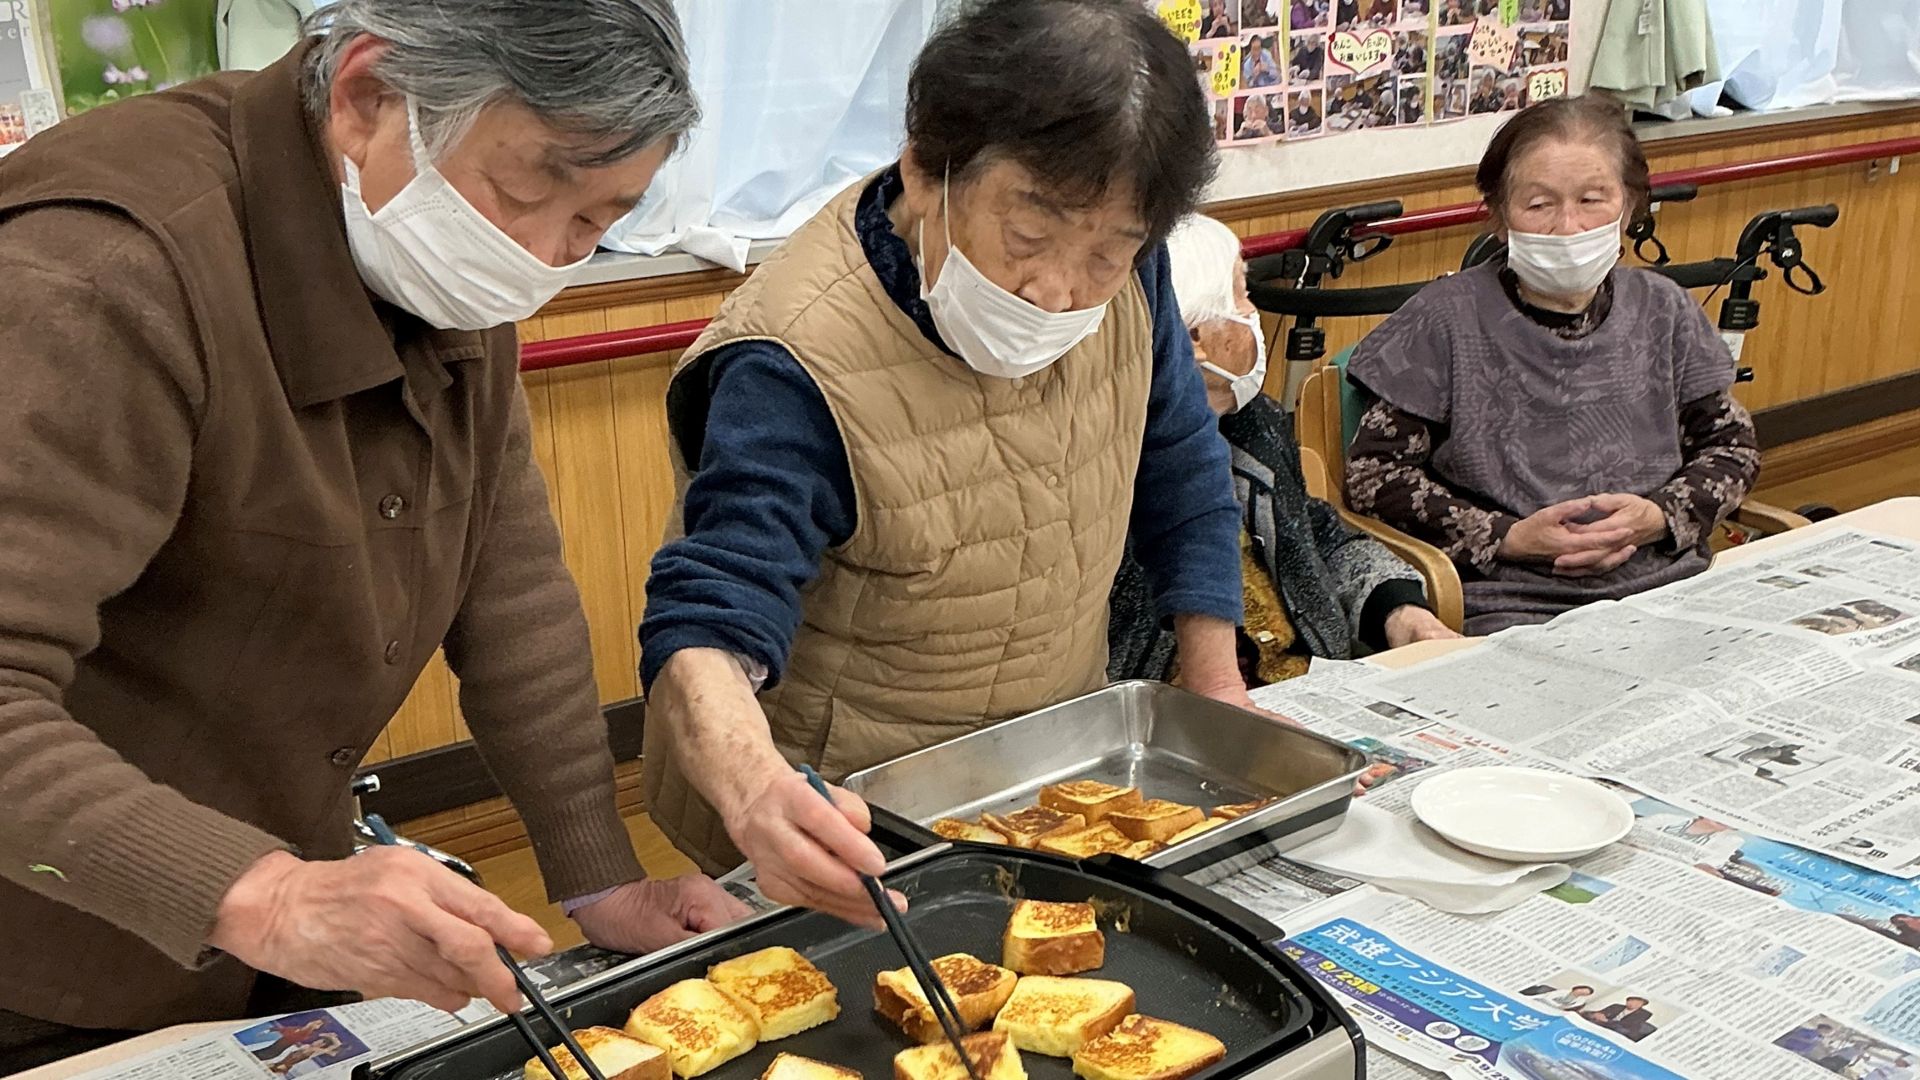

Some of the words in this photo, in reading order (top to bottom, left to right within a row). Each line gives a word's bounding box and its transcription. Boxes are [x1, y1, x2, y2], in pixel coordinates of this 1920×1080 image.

[1534, 78, 1563, 98] うまい
[1318, 923, 1551, 1032] 武雄アジア大学
